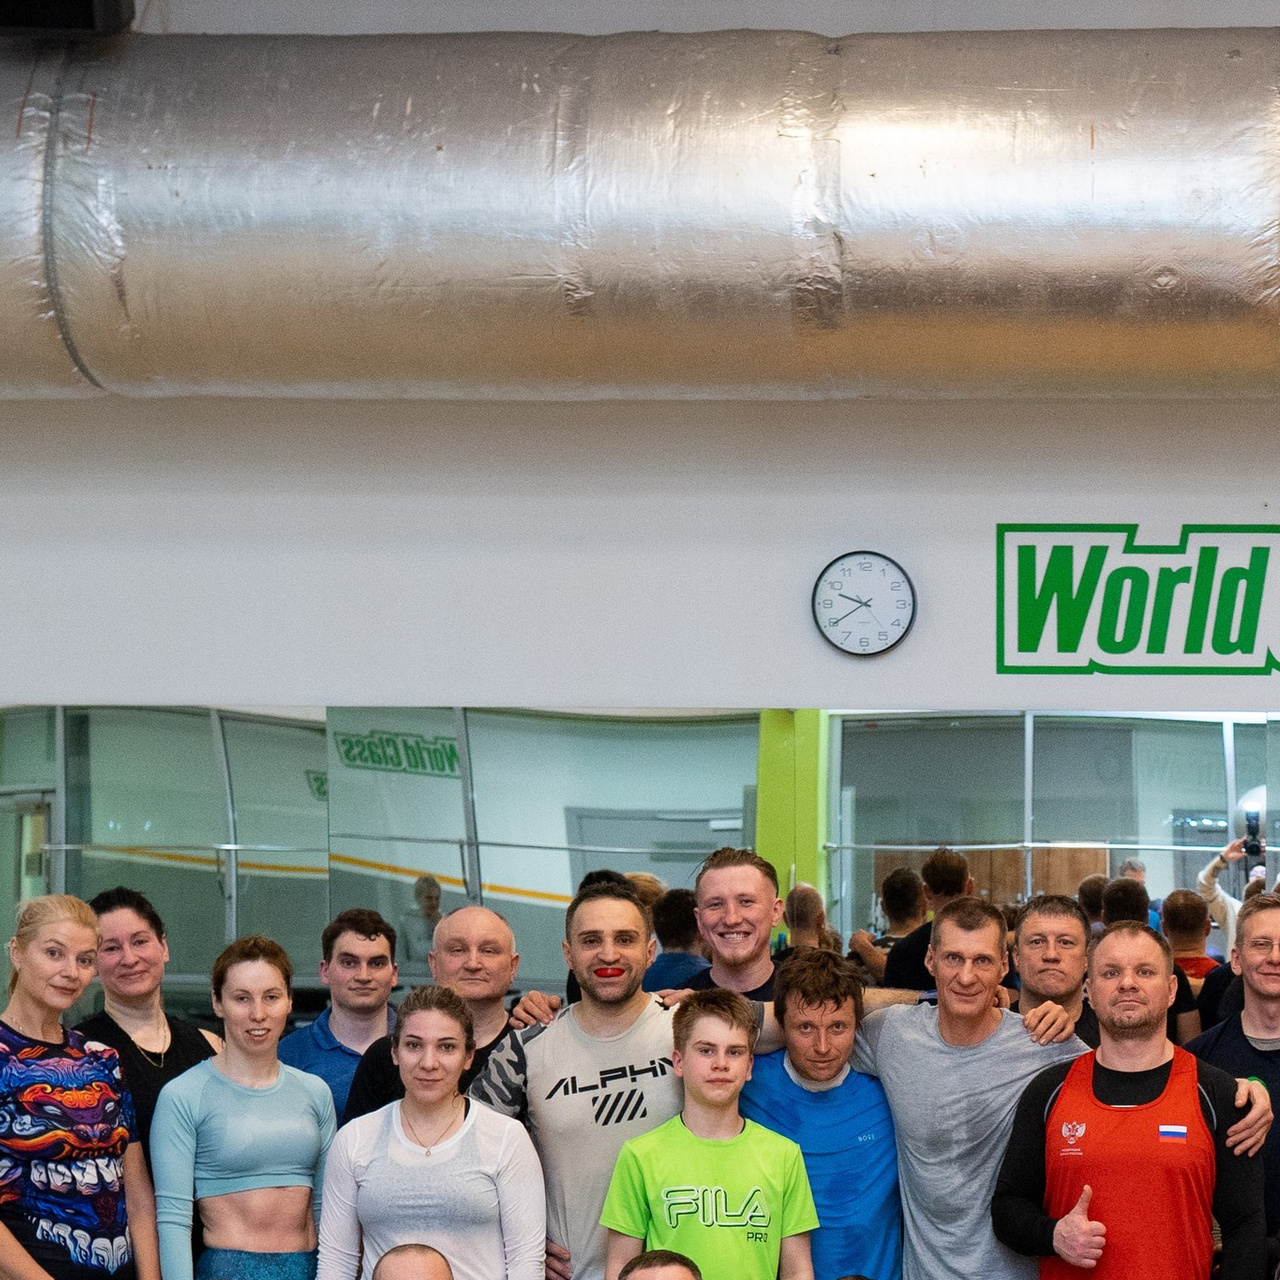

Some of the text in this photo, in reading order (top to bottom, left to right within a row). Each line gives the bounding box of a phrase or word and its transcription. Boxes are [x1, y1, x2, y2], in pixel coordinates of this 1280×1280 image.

[857, 561, 873, 572] 12
[840, 568, 852, 577] 11
[880, 568, 886, 577] 1
[827, 581, 843, 591] 10
[890, 581, 901, 591] 2
[822, 599, 833, 609] 9
[896, 599, 907, 609] 3
[1017, 544, 1271, 655] World
[891, 618, 901, 627] 4
[841, 631, 852, 640] 7
[878, 631, 888, 641] 5
[859, 637, 870, 647] 6
[661, 1186, 771, 1229] FILA
